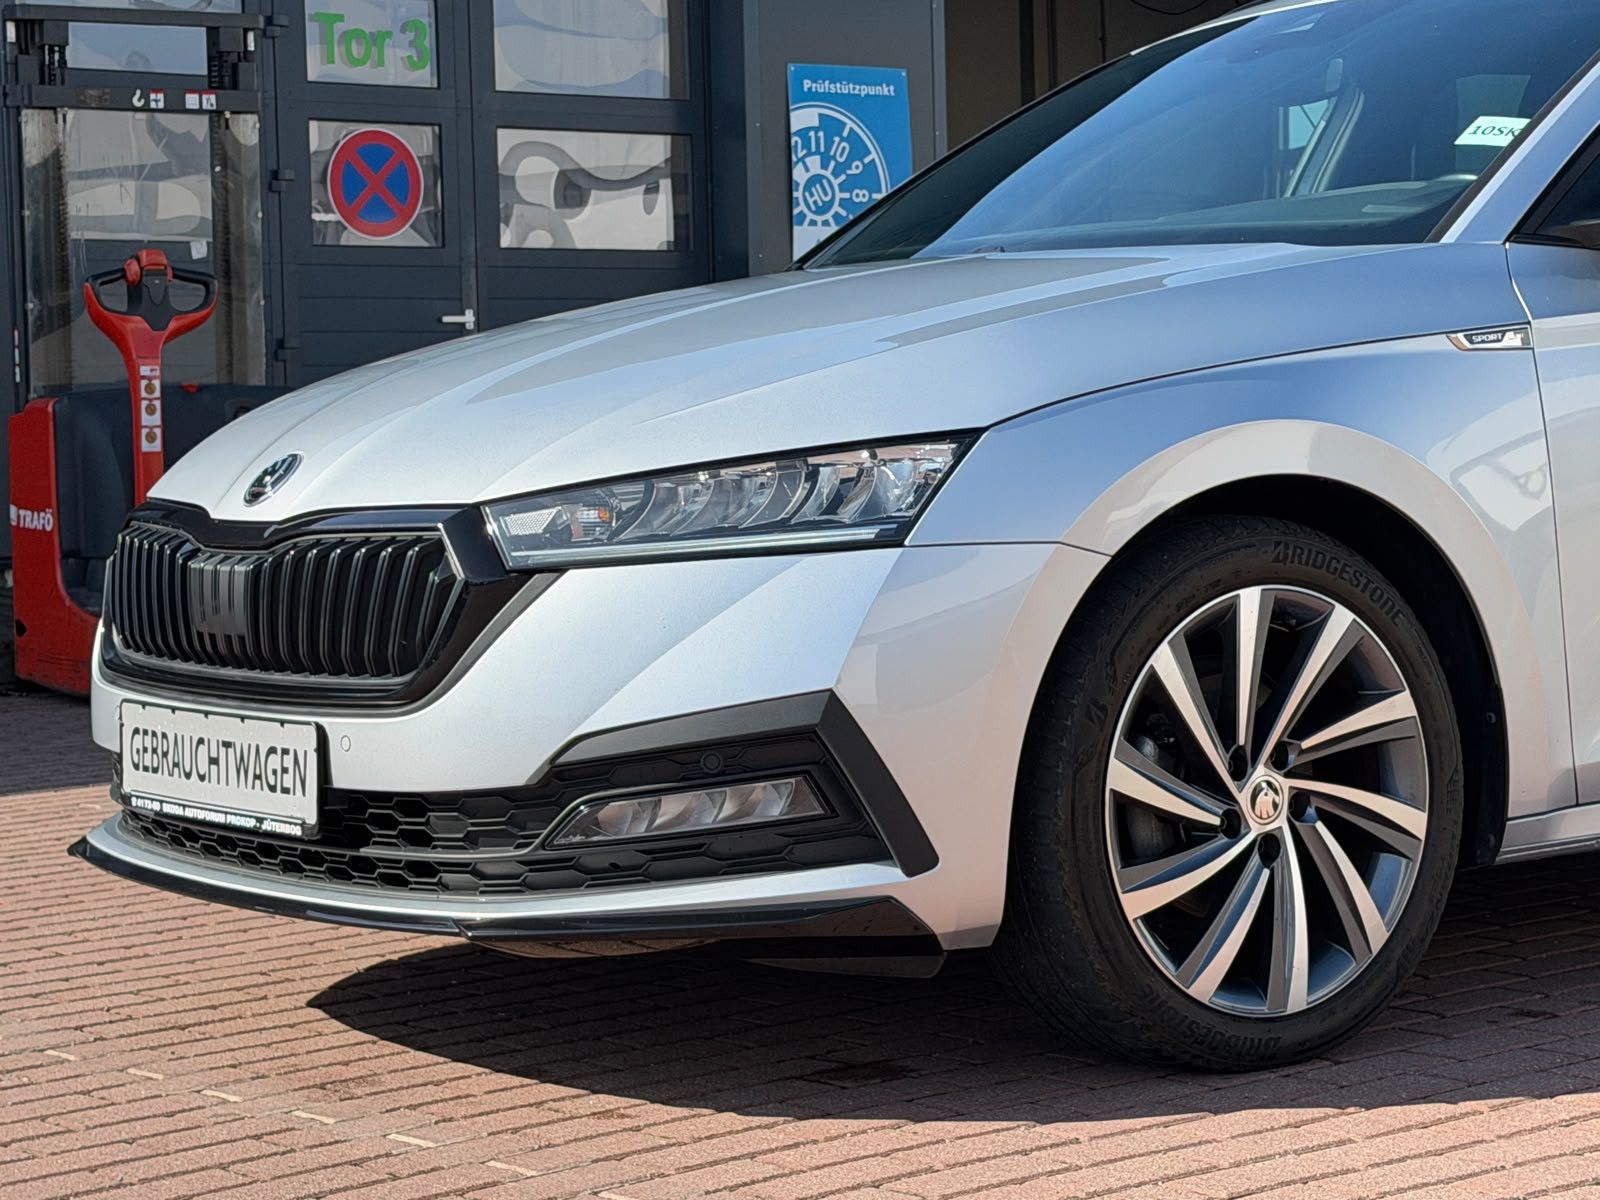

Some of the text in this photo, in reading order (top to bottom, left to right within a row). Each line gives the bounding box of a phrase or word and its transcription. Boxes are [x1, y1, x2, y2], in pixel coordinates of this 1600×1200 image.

[312, 11, 431, 71] Tor 3
[803, 79, 896, 97] Prüfstützpunkt
[808, 130, 825, 153] 11
[830, 136, 850, 163] 10
[846, 160, 863, 175] 9
[804, 178, 832, 211] HU
[852, 188, 870, 203] 8
[1471, 332, 1504, 343] SPORT
[18, 508, 54, 532] TRAFÖ
[1271, 539, 1406, 627] BRIDGESTONE
[129, 726, 308, 798] GEBRAUCHTWAGEN
